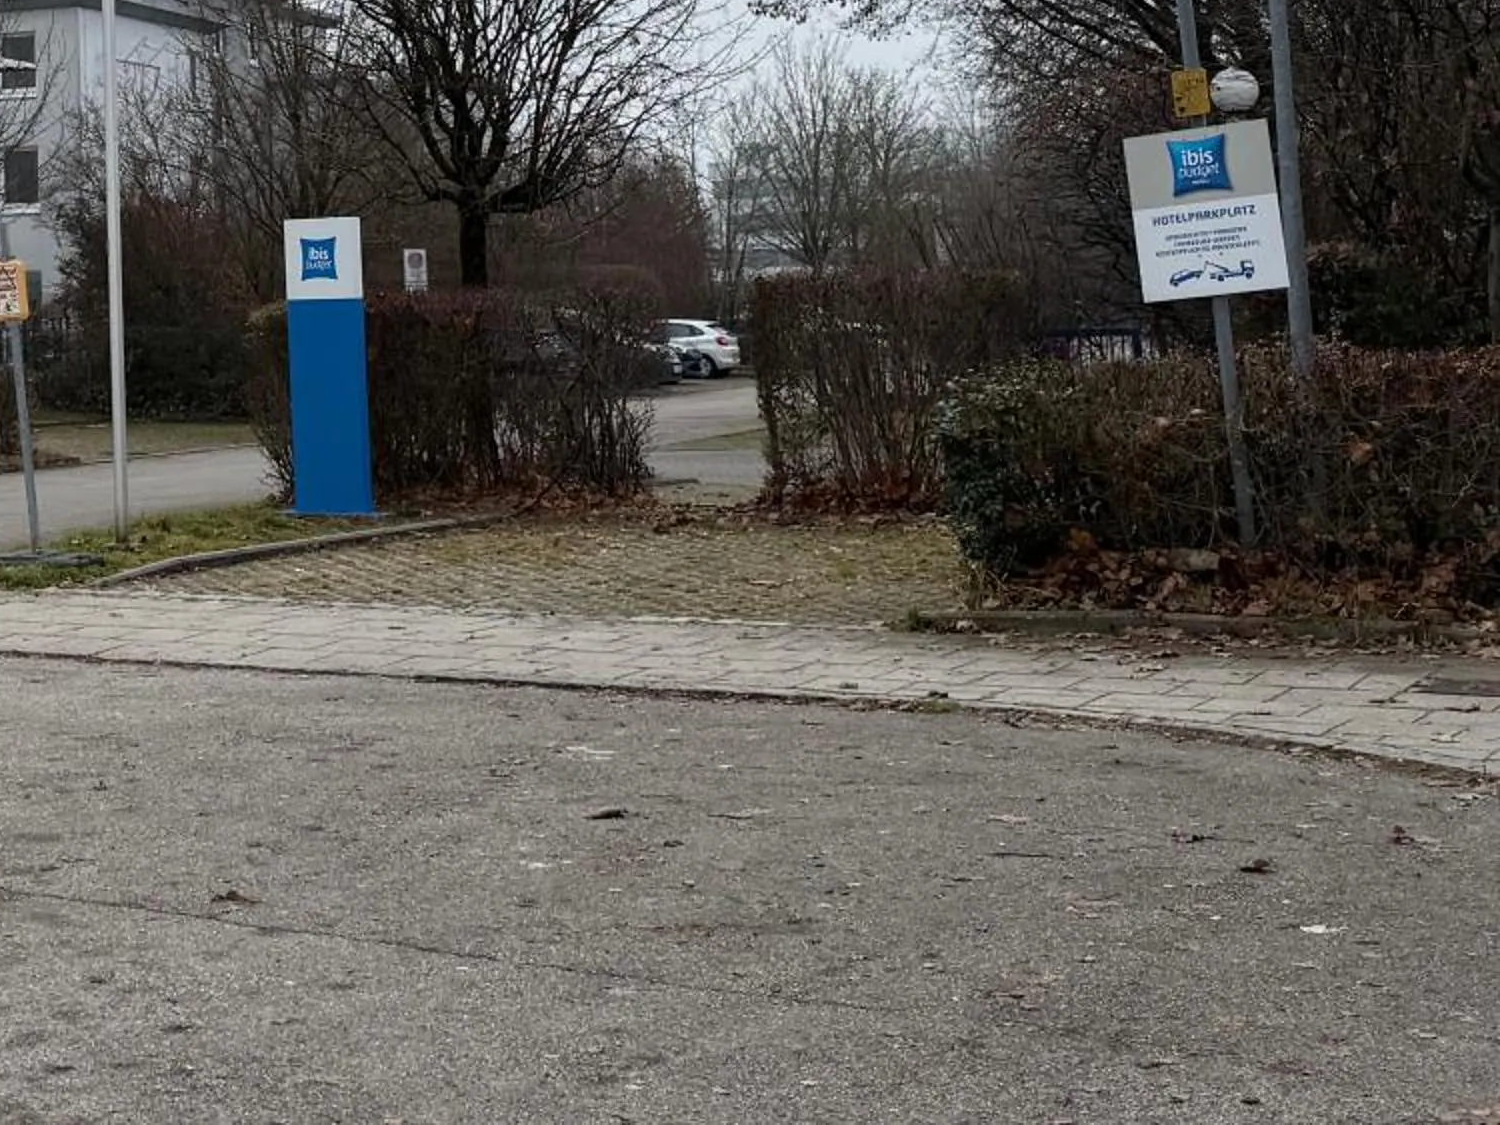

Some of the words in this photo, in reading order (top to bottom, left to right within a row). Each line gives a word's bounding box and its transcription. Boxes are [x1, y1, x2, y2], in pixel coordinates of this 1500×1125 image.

[1181, 146, 1214, 167] ibis
[1152, 204, 1257, 227] HOTELPARKPLATZ
[309, 246, 329, 261] ibis
